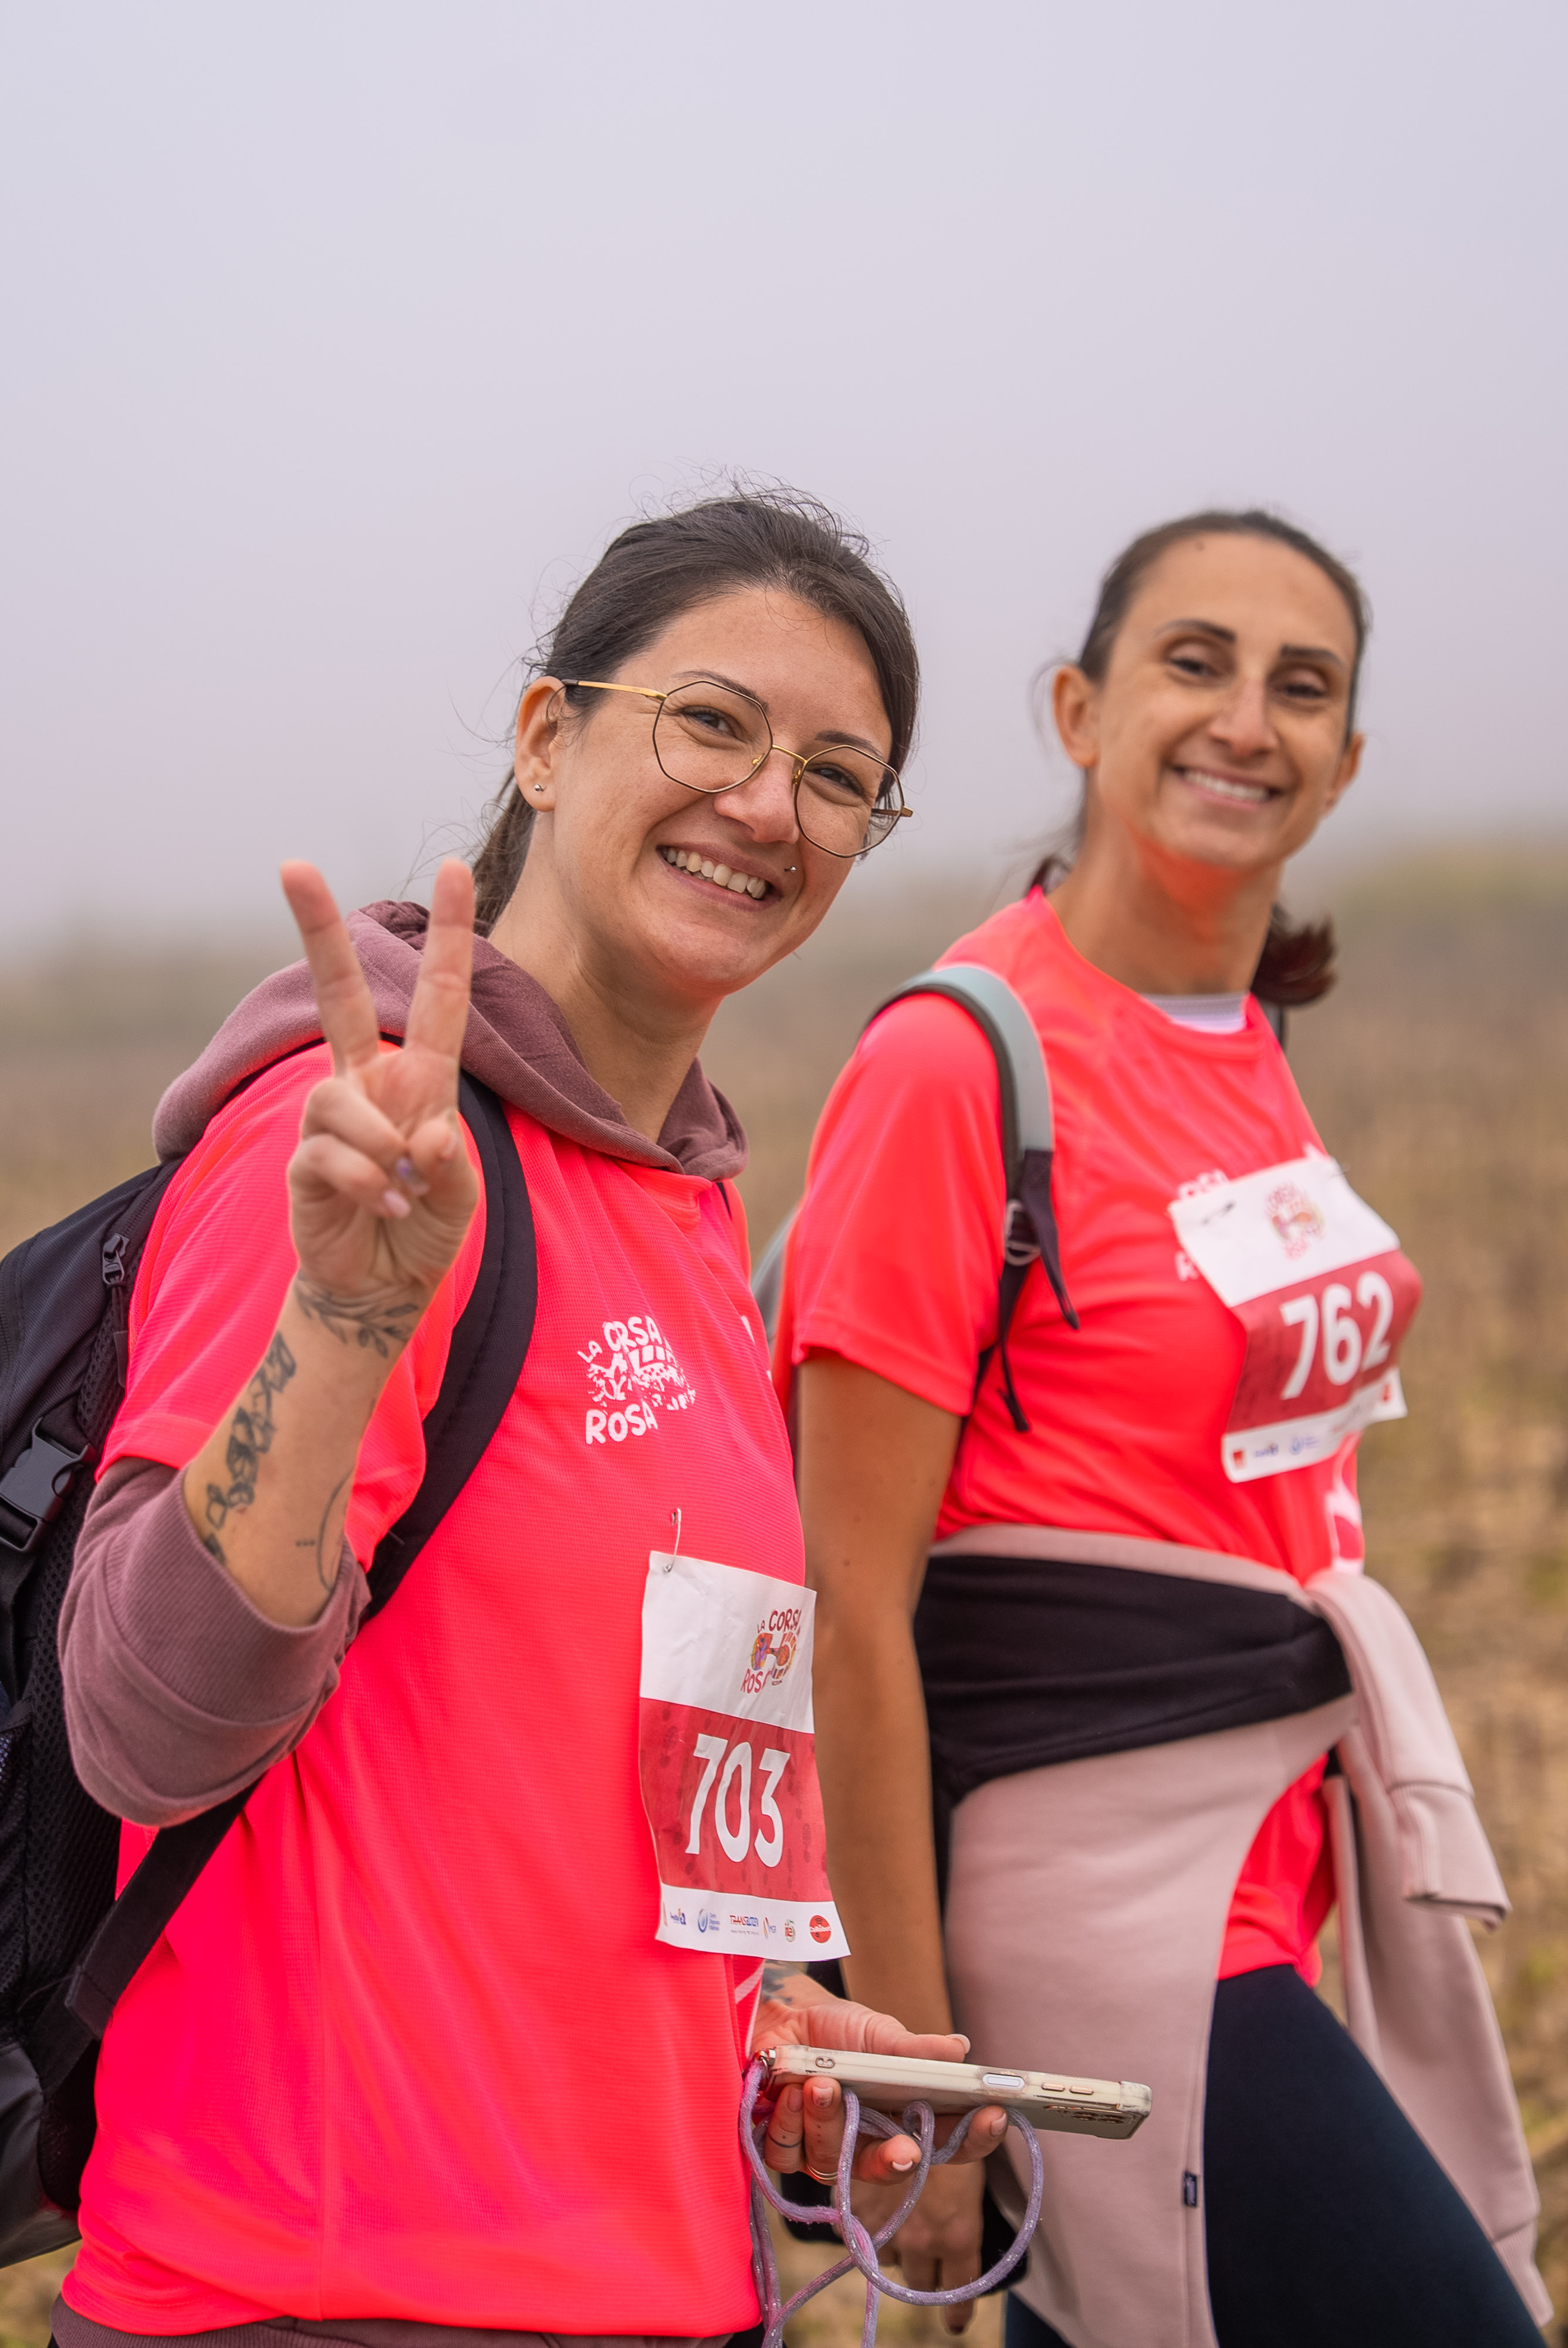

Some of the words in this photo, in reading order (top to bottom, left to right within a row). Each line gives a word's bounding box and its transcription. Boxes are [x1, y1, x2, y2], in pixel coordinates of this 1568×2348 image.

[577, 1340, 603, 1363] LA
[1280, 1271, 1394, 1401] 762
[586, 1399, 658, 1445] ROSA
[685, 1733, 791, 1868] 703
